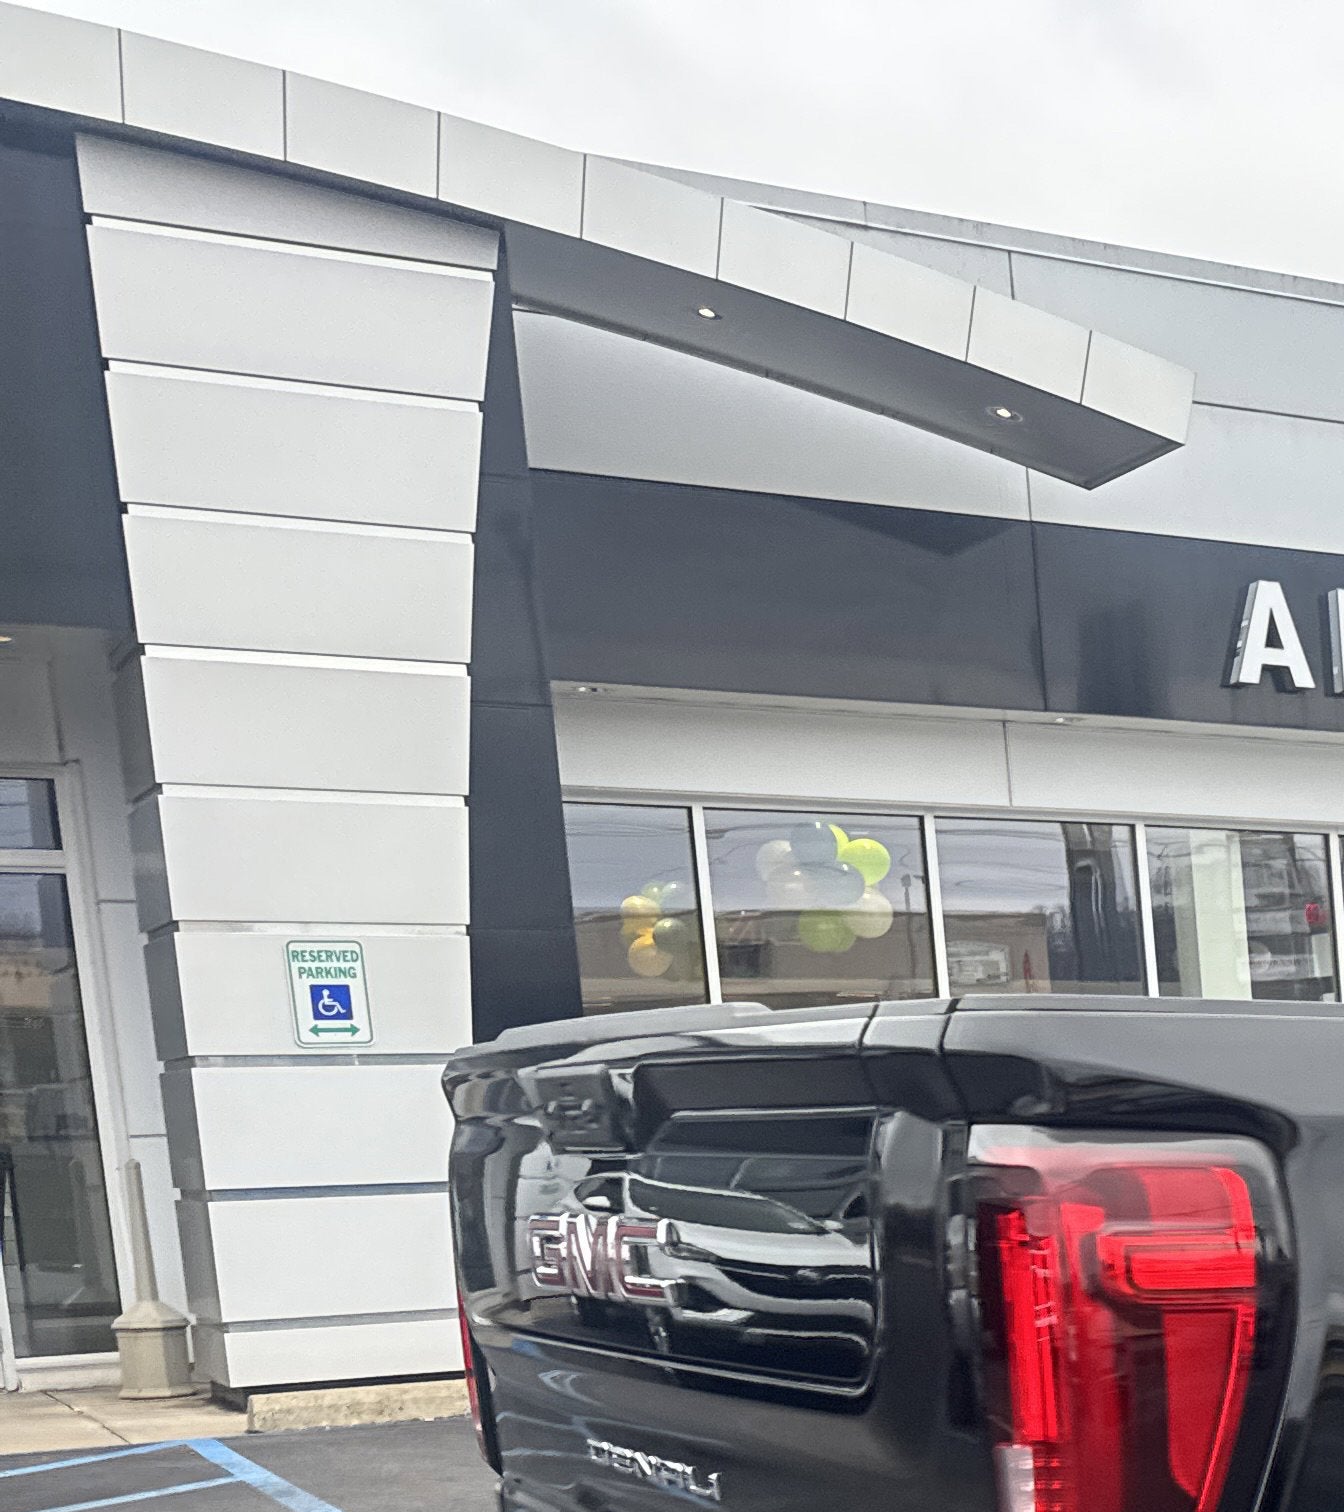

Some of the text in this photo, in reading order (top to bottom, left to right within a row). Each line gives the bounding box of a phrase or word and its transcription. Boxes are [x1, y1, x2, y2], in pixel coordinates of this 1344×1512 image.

[291, 949, 359, 963] RESERVED
[298, 966, 357, 979] PARKING
[528, 1212, 678, 1302] GMC
[586, 1438, 722, 1500] DENALI
